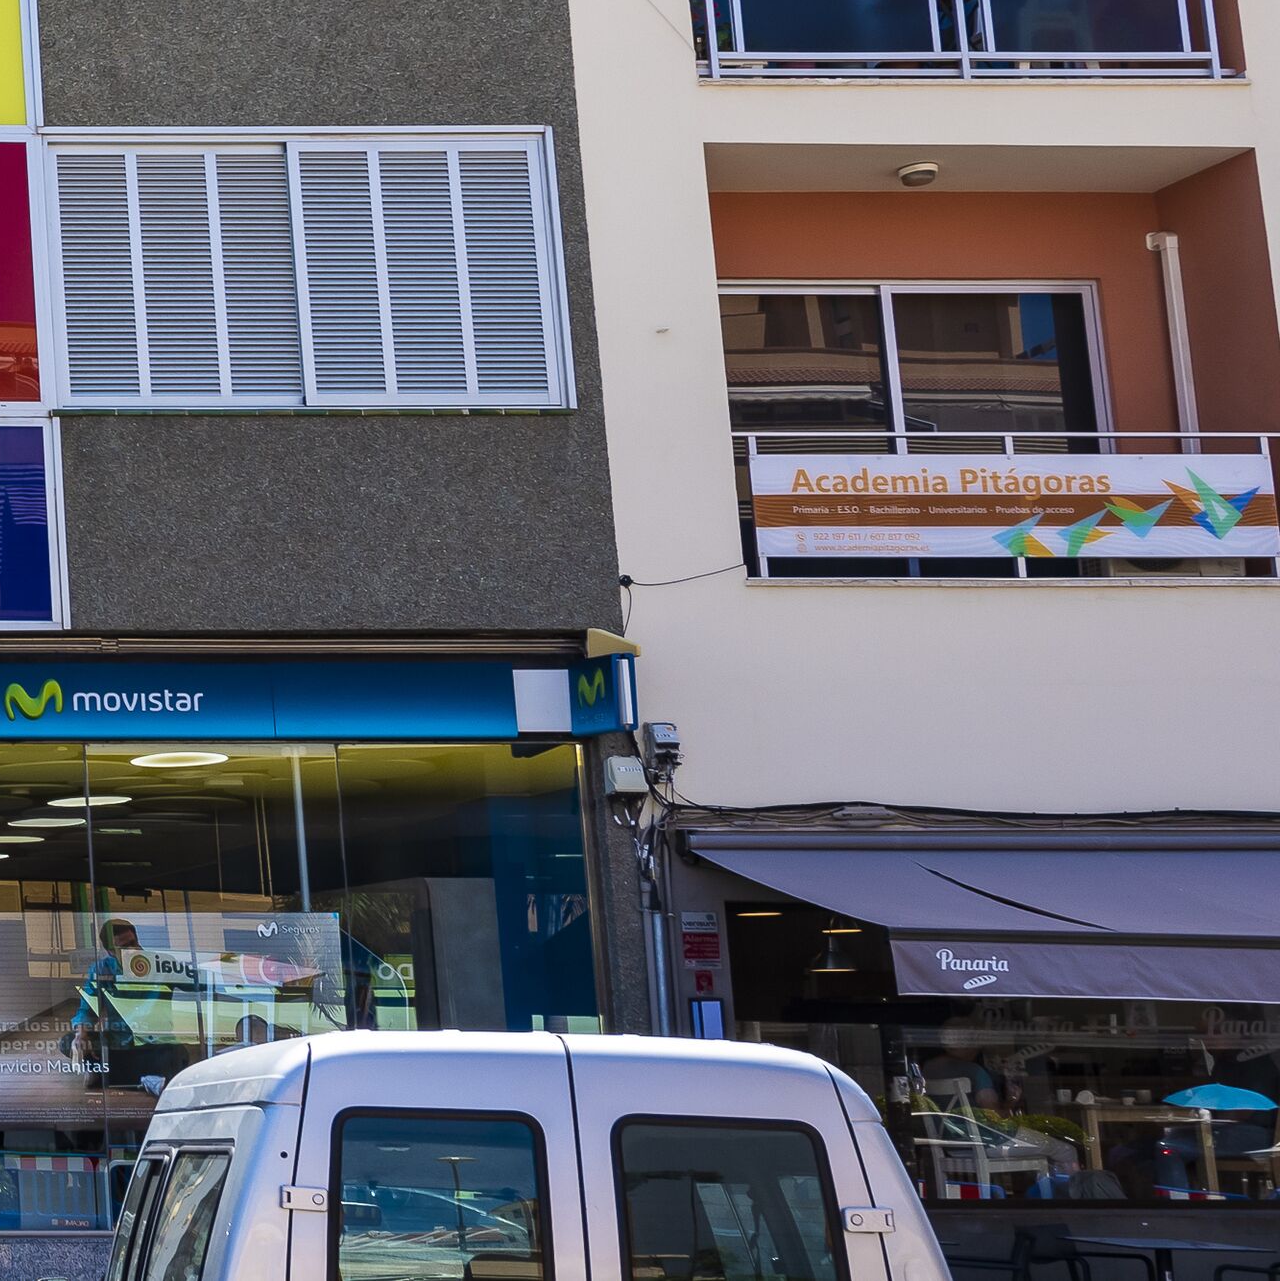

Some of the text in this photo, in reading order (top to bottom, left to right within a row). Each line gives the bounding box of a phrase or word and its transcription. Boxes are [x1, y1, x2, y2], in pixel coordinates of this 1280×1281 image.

[791, 467, 1112, 501] Academia Pitágoras
[792, 505, 830, 514] Primaria
[869, 505, 921, 514] Bachillerato
[928, 506, 988, 514] Universitarios
[995, 505, 1031, 514] Pruebas
[1045, 506, 1075, 514] acceso
[72, 689, 204, 712] movistar
[281, 924, 321, 935] Seguros
[935, 948, 1010, 972] Panaria
[26, 1018, 50, 1032] los
[47, 1059, 110, 1073] Manitas
